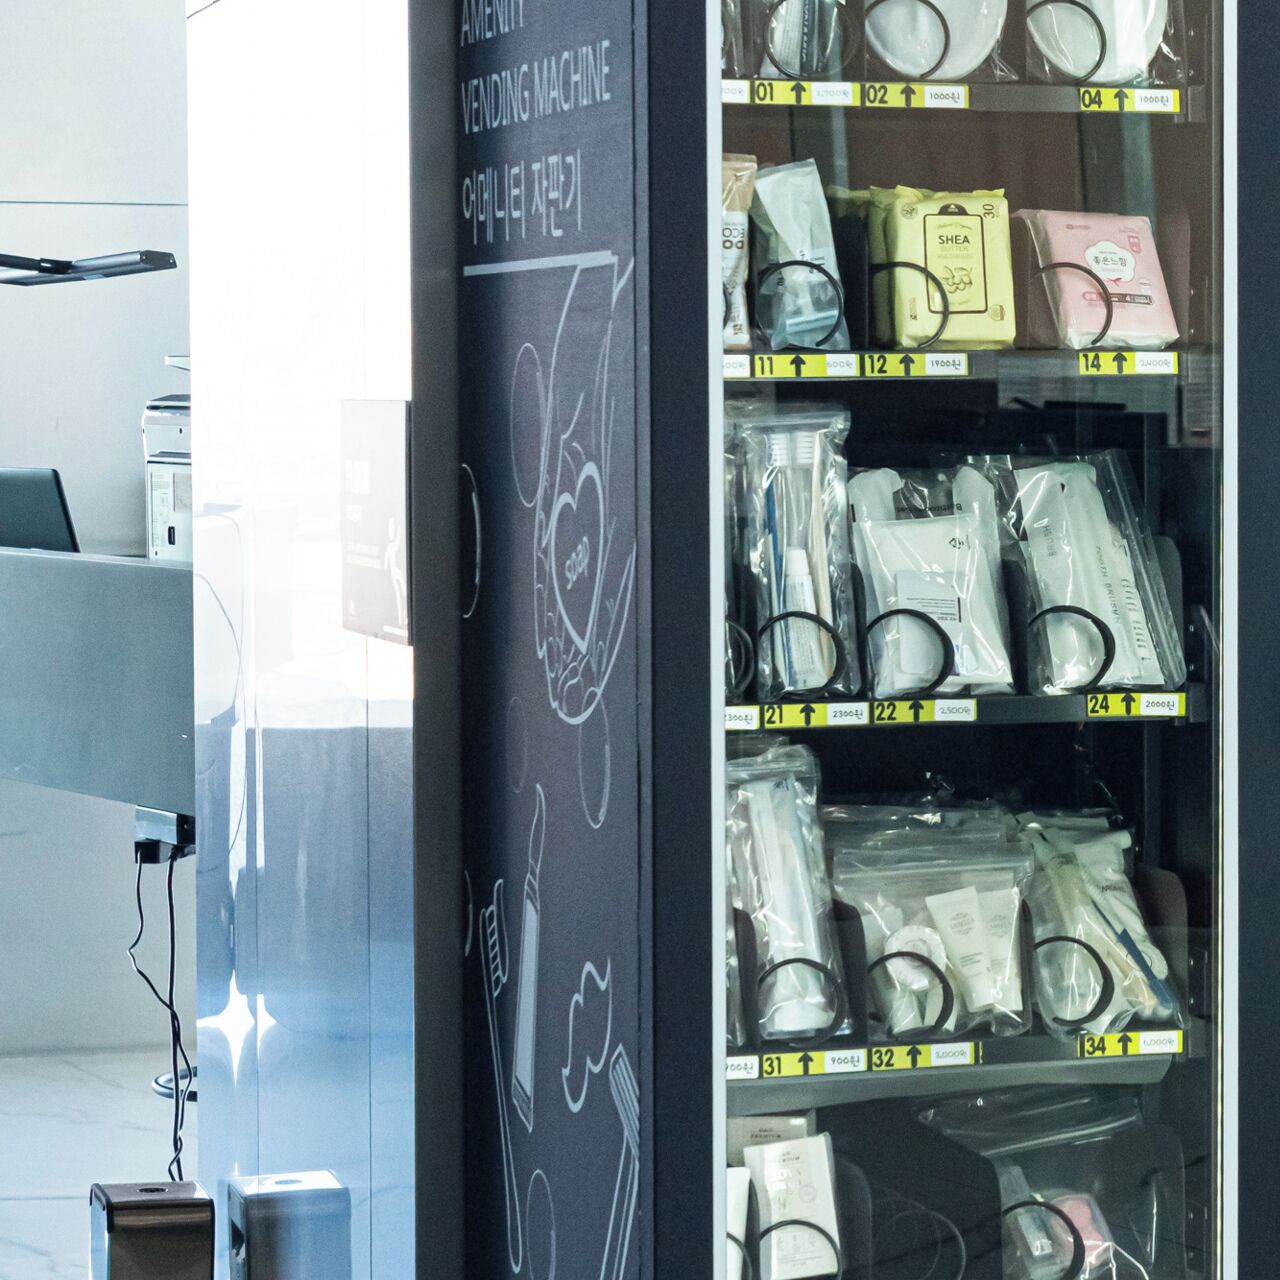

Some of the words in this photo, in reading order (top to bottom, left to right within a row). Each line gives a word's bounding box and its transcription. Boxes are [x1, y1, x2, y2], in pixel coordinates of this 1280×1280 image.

[461, 63, 529, 135] VENDING
[533, 39, 611, 118] MACHINE
[756, 82, 774, 102] 01
[866, 84, 889, 105] 02
[1081, 89, 1103, 110] 04
[462, 160, 525, 246] 어메니티
[531, 148, 581, 238] 자판기
[938, 235, 971, 245] SHEA
[759, 356, 773, 376] 11
[868, 354, 889, 374] 12
[1082, 353, 1102, 373] 14
[564, 535, 590, 590] soap
[876, 702, 897, 722] 22
[1090, 694, 1110, 714] 24
[1145, 700, 1175, 712] 2000원
[766, 704, 783, 725] 21
[833, 708, 864, 720] 2300원
[1086, 1036, 1106, 1056] 34
[764, 1056, 782, 1076] 31
[873, 1048, 895, 1068] 32
